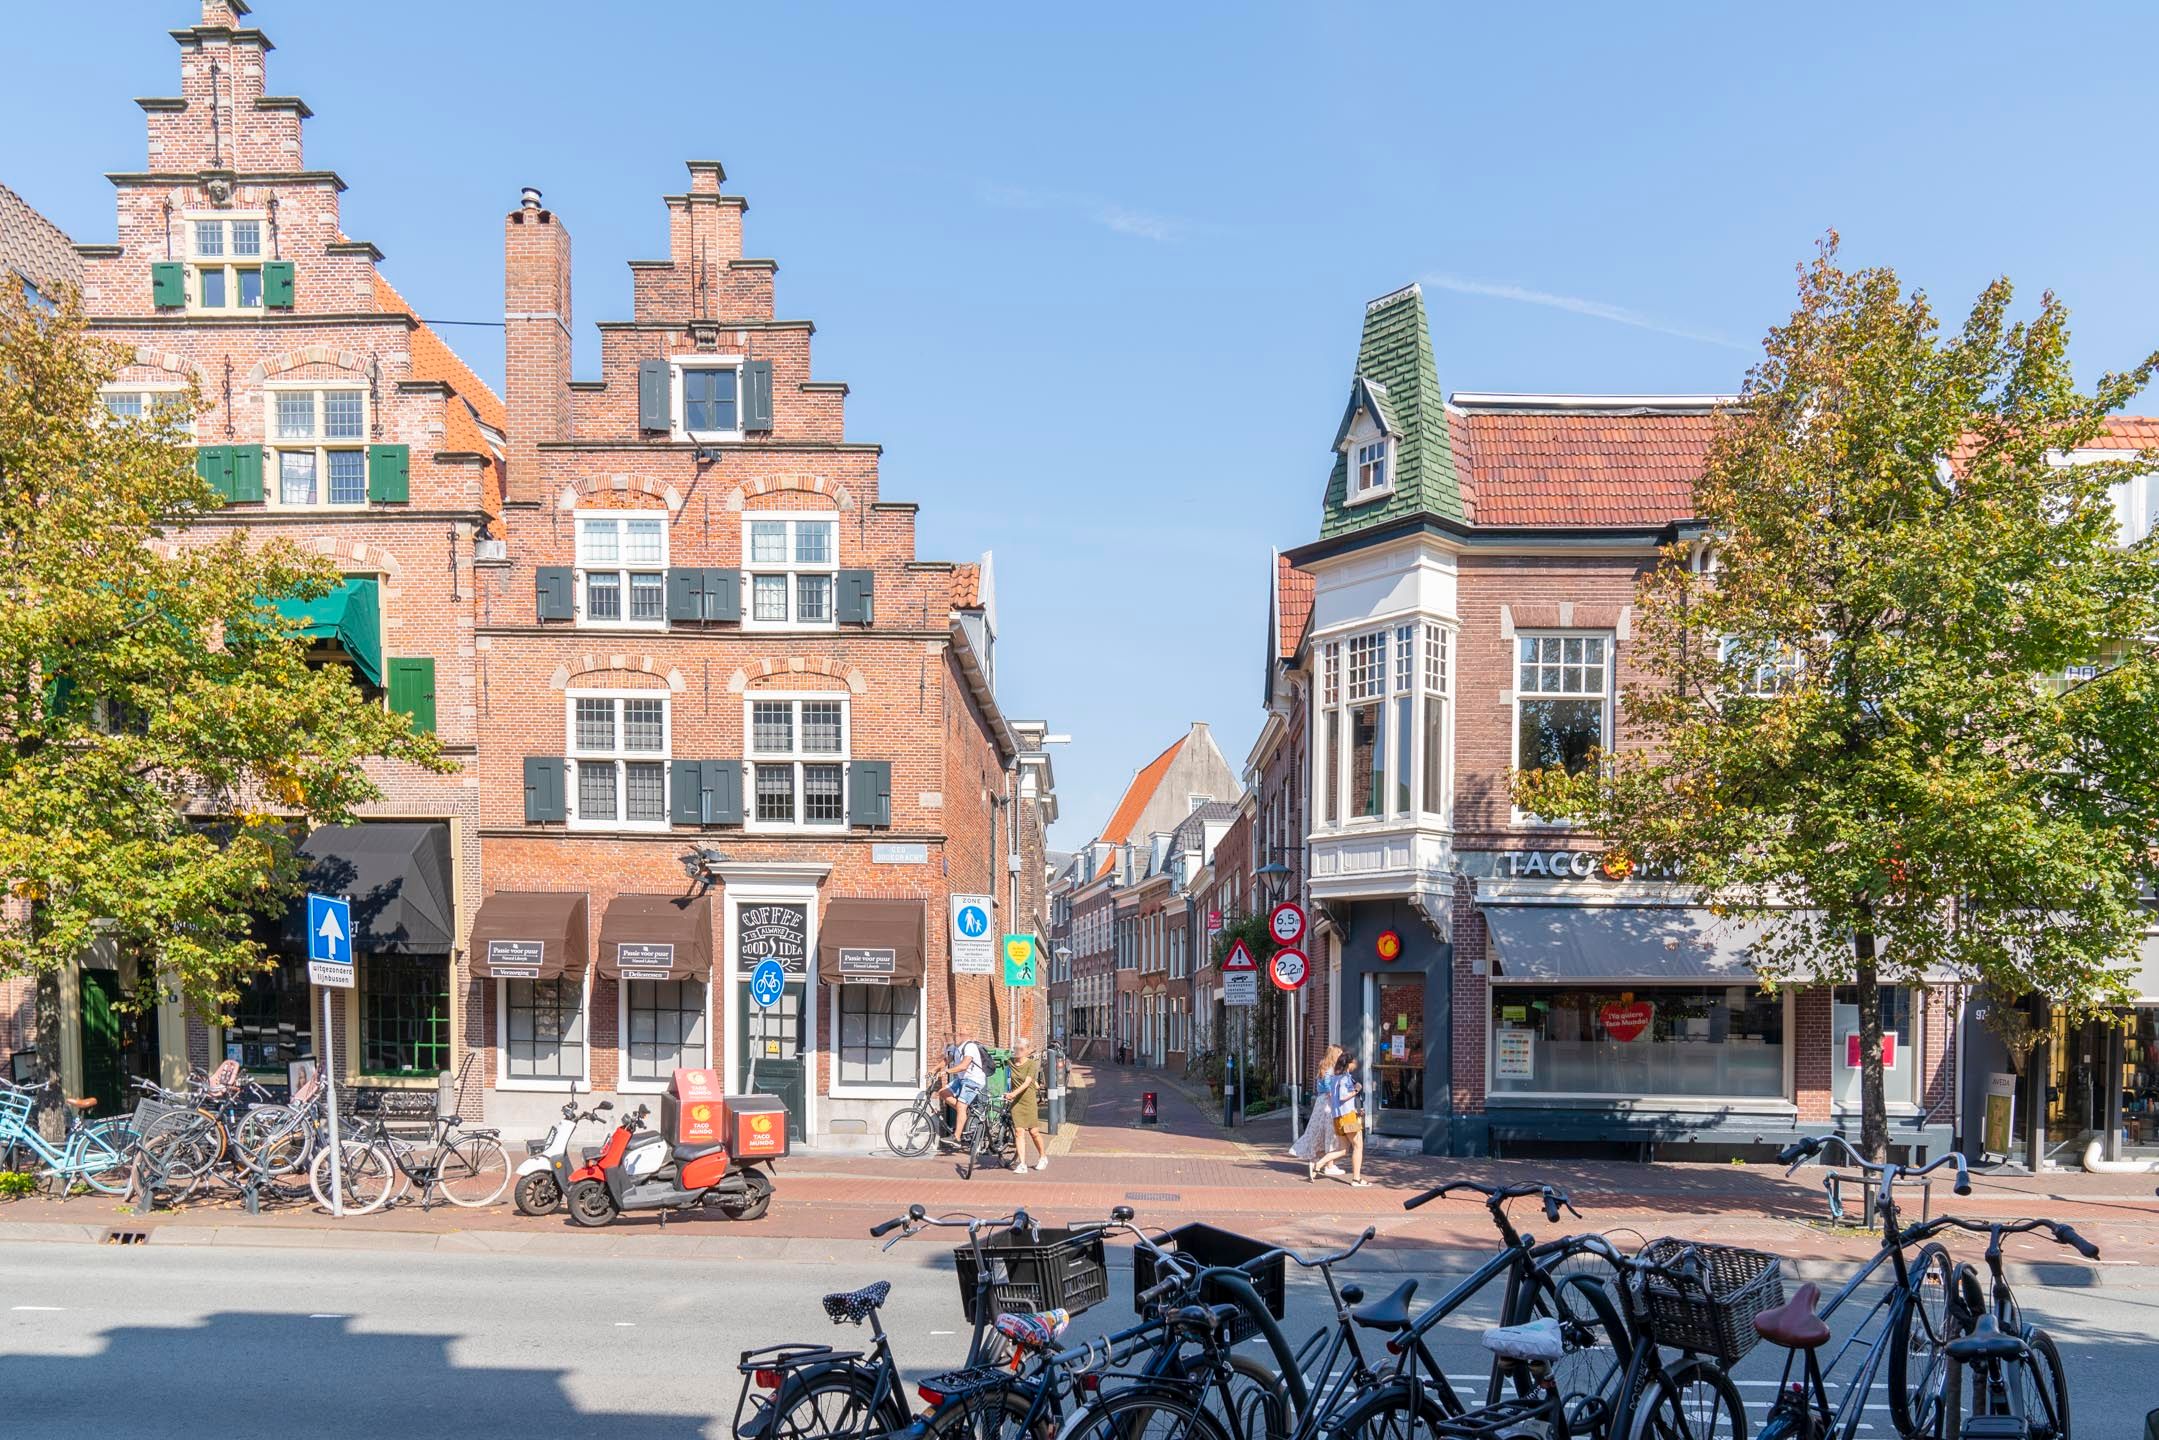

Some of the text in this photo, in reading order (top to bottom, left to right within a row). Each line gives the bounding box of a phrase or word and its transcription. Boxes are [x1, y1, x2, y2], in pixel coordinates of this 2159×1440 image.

[1505, 851, 1597, 877] TACO
[742, 907, 803, 927] COFFEE
[761, 927, 786, 935] ALWAYS
[493, 946, 510, 954] Passie
[742, 941, 803, 955] GOOD IDEA
[313, 966, 352, 975] uitgezonderd
[317, 974, 349, 983] lijnbussen
[1621, 1012, 1644, 1020] quiero
[1621, 1017, 1649, 1026] Mundo!
